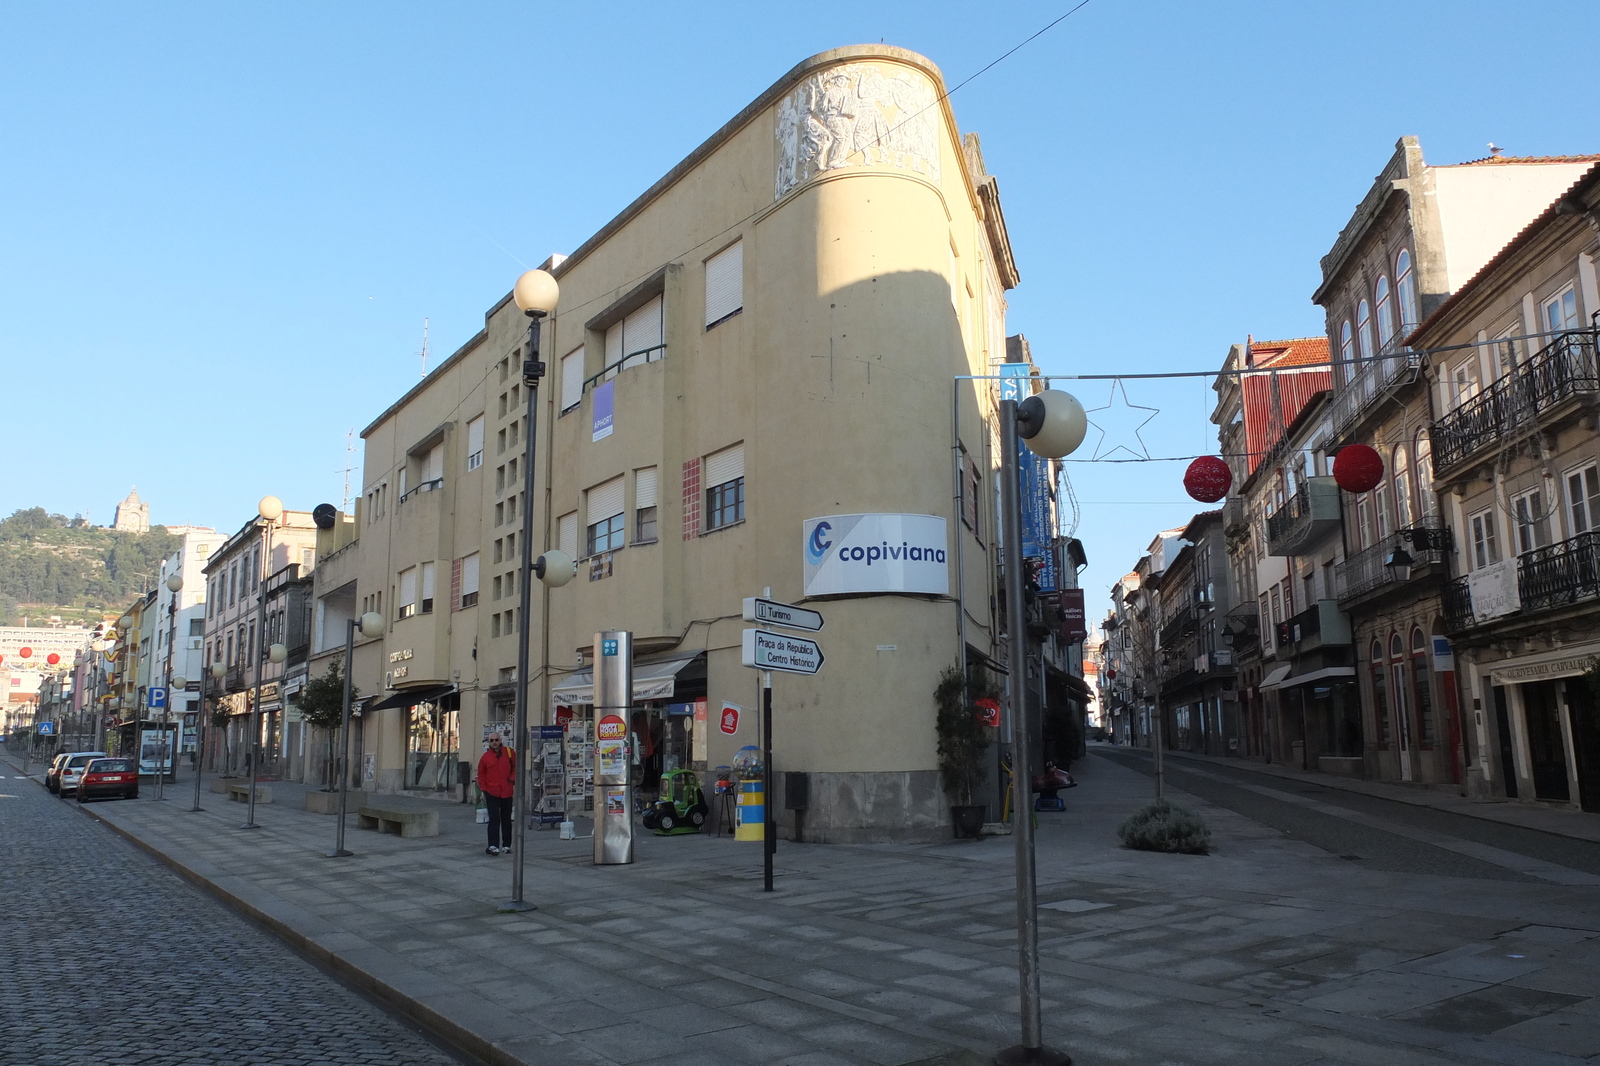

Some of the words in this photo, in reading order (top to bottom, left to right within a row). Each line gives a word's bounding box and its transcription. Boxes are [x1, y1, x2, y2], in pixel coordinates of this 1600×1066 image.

[593, 415, 613, 430] APHORT
[839, 541, 945, 566] copiviana
[768, 607, 791, 621] Turismo
[758, 636, 775, 649] Praça
[777, 641, 785, 651] da
[786, 642, 814, 655] República
[767, 652, 789, 664] Centro
[790, 655, 815, 668] Histórico
[1507, 664, 1549, 679] OURIVESARIA
[1551, 658, 1590, 673] CARVALHO
[152, 689, 165, 706] P
